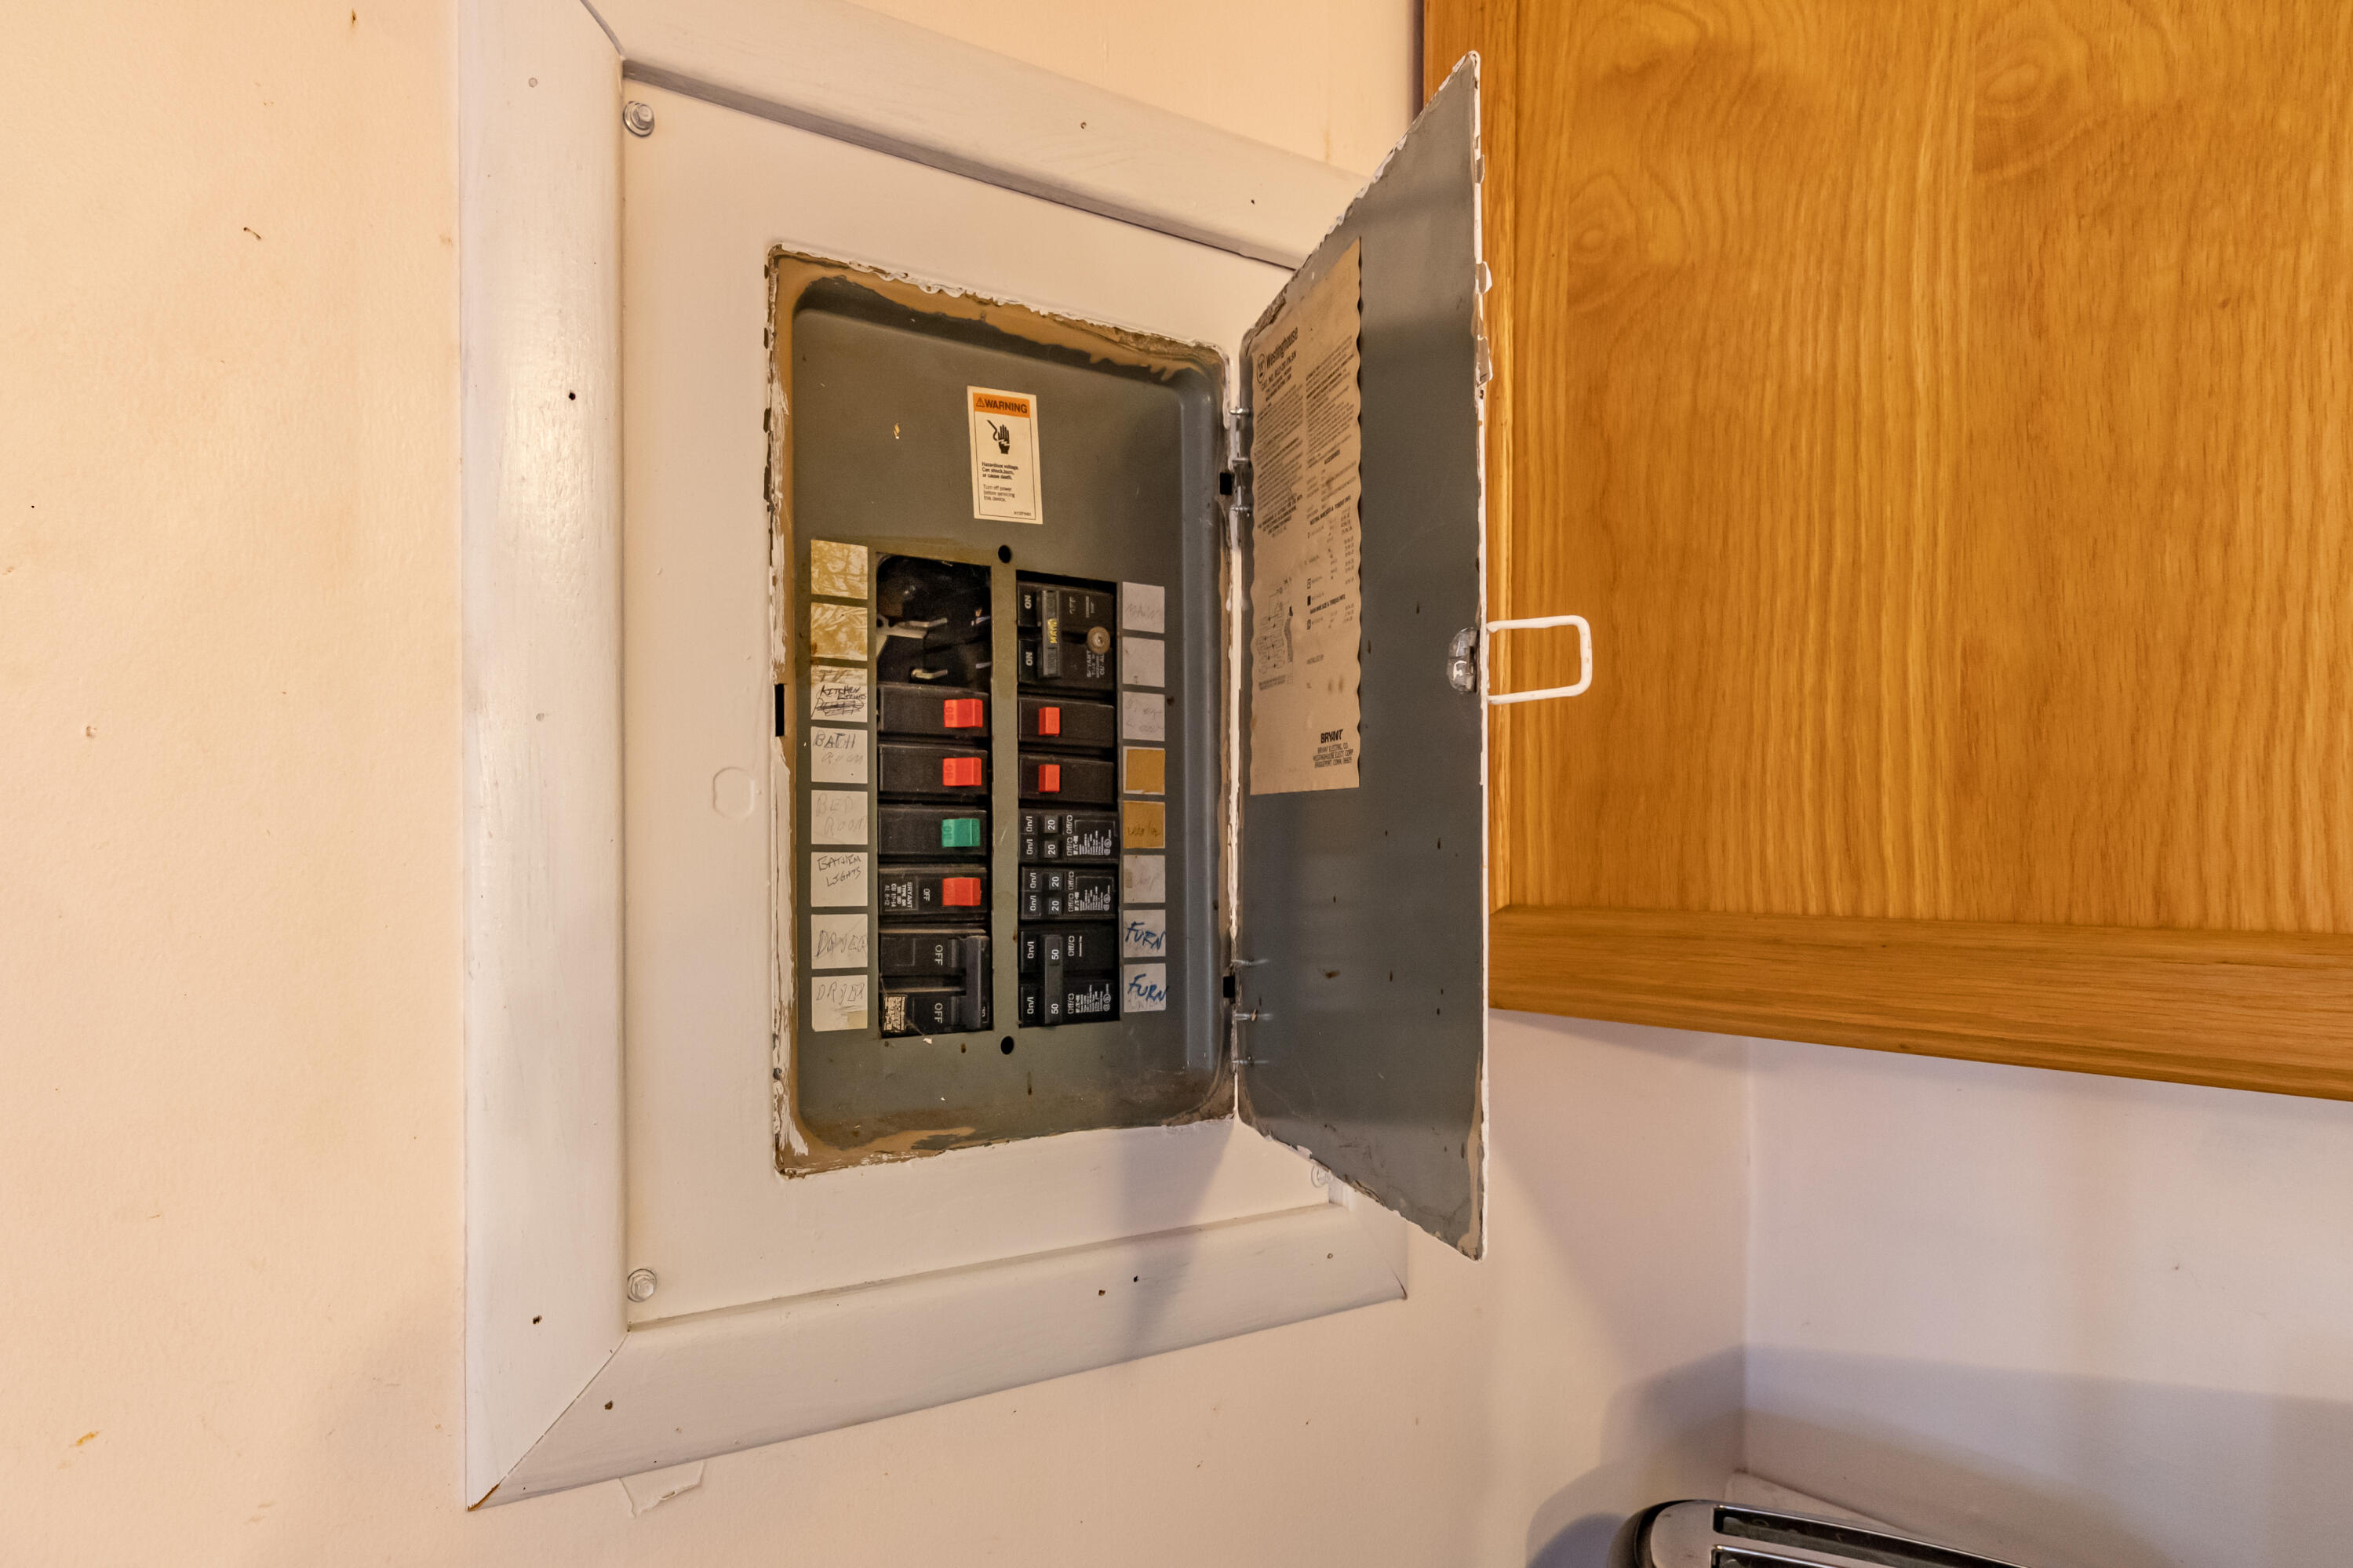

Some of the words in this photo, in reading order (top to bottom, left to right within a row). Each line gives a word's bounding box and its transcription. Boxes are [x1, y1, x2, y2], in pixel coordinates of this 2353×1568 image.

[1266, 326, 1298, 369] Westinghouse
[984, 398, 1028, 414] WARNING
[1024, 595, 1032, 609] ON
[1047, 618, 1058, 643] MAIN
[1025, 652, 1033, 666] ON
[814, 730, 856, 750] BATH
[1320, 729, 1343, 744] BRYANT
[1047, 820, 1055, 830] 20
[1047, 844, 1056, 855] 20
[826, 866, 861, 886] LIGHTS
[1052, 876, 1059, 887] 20
[1052, 900, 1059, 911] 20
[1125, 921, 1166, 950] FURN
[934, 944, 943, 966] OFF
[1052, 949, 1059, 960] 50
[1127, 973, 1169, 1002] FURN
[934, 1003, 943, 1024] OFF
[1051, 1003, 1058, 1014] 50
